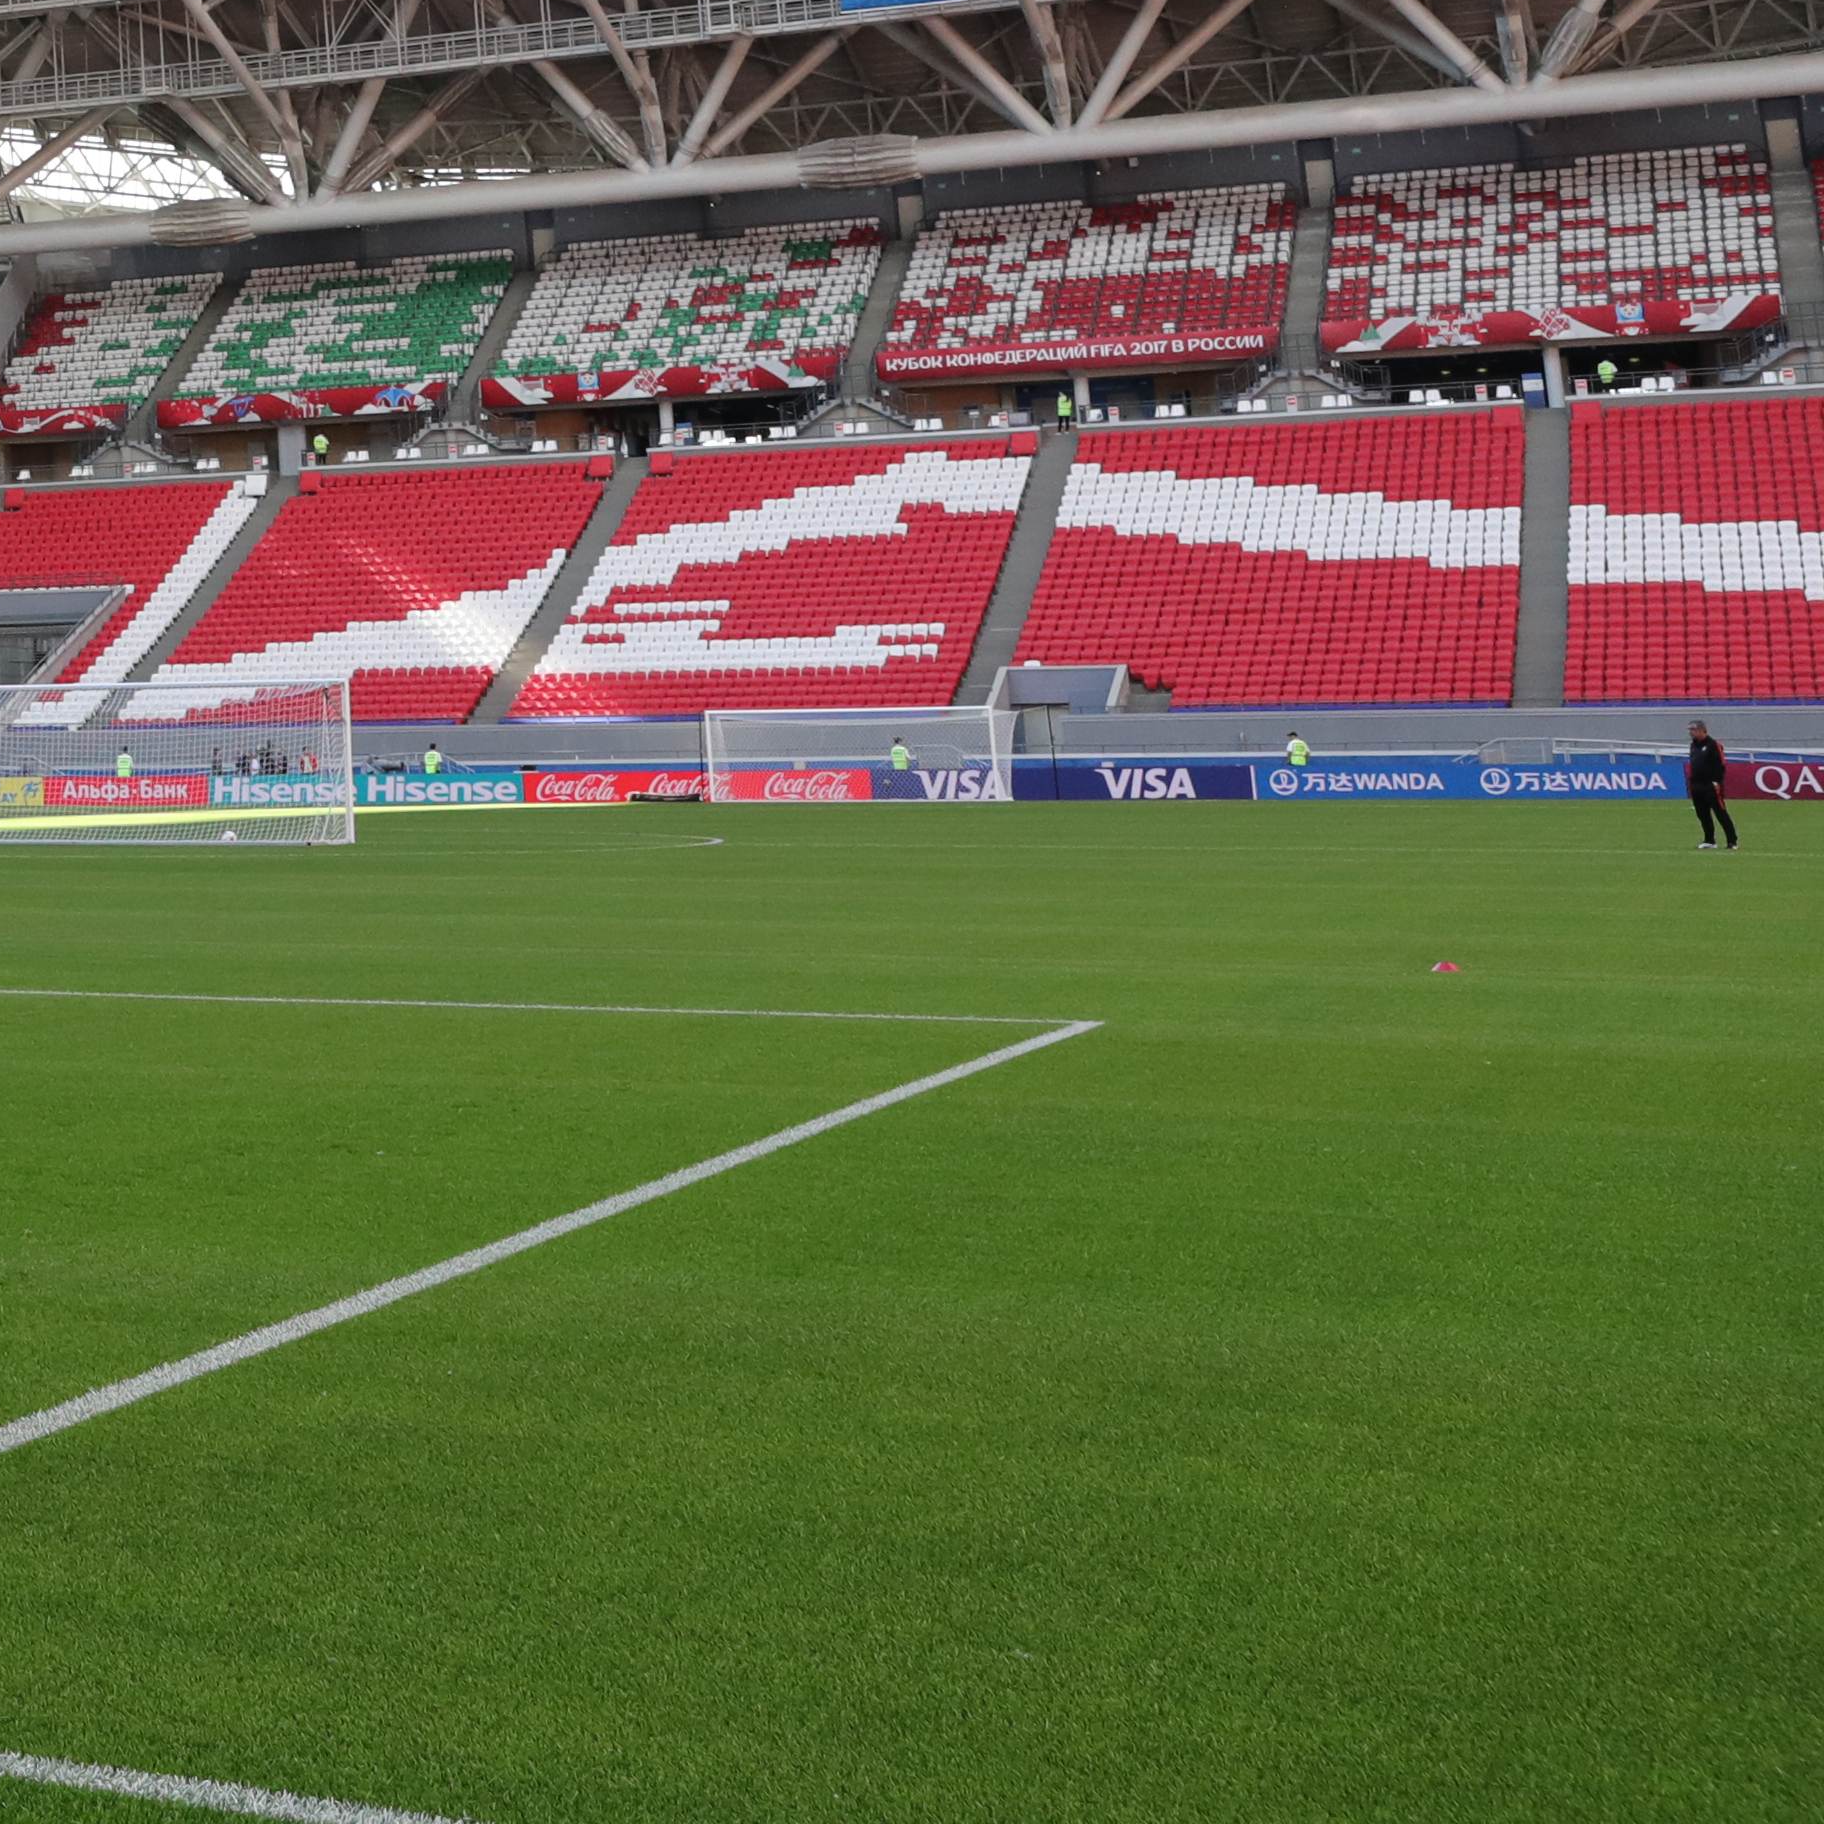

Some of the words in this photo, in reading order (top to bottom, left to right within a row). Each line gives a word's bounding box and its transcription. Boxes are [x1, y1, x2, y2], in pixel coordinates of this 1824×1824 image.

[886, 355, 943, 372] КУБОК
[946, 343, 1088, 368] КОНФЕДЕРАЦИЙ
[1090, 342, 1127, 358] FIFA
[1130, 339, 1168, 355] 2017
[1171, 337, 1184, 353] В
[1187, 334, 1264, 352] РОССИИ
[367, 775, 518, 803] Hisense
[536, 772, 618, 801] Coca-Cola
[763, 771, 849, 800] Coca-Cola
[1094, 767, 1196, 799] VISA
[1755, 765, 1824, 800] QA
